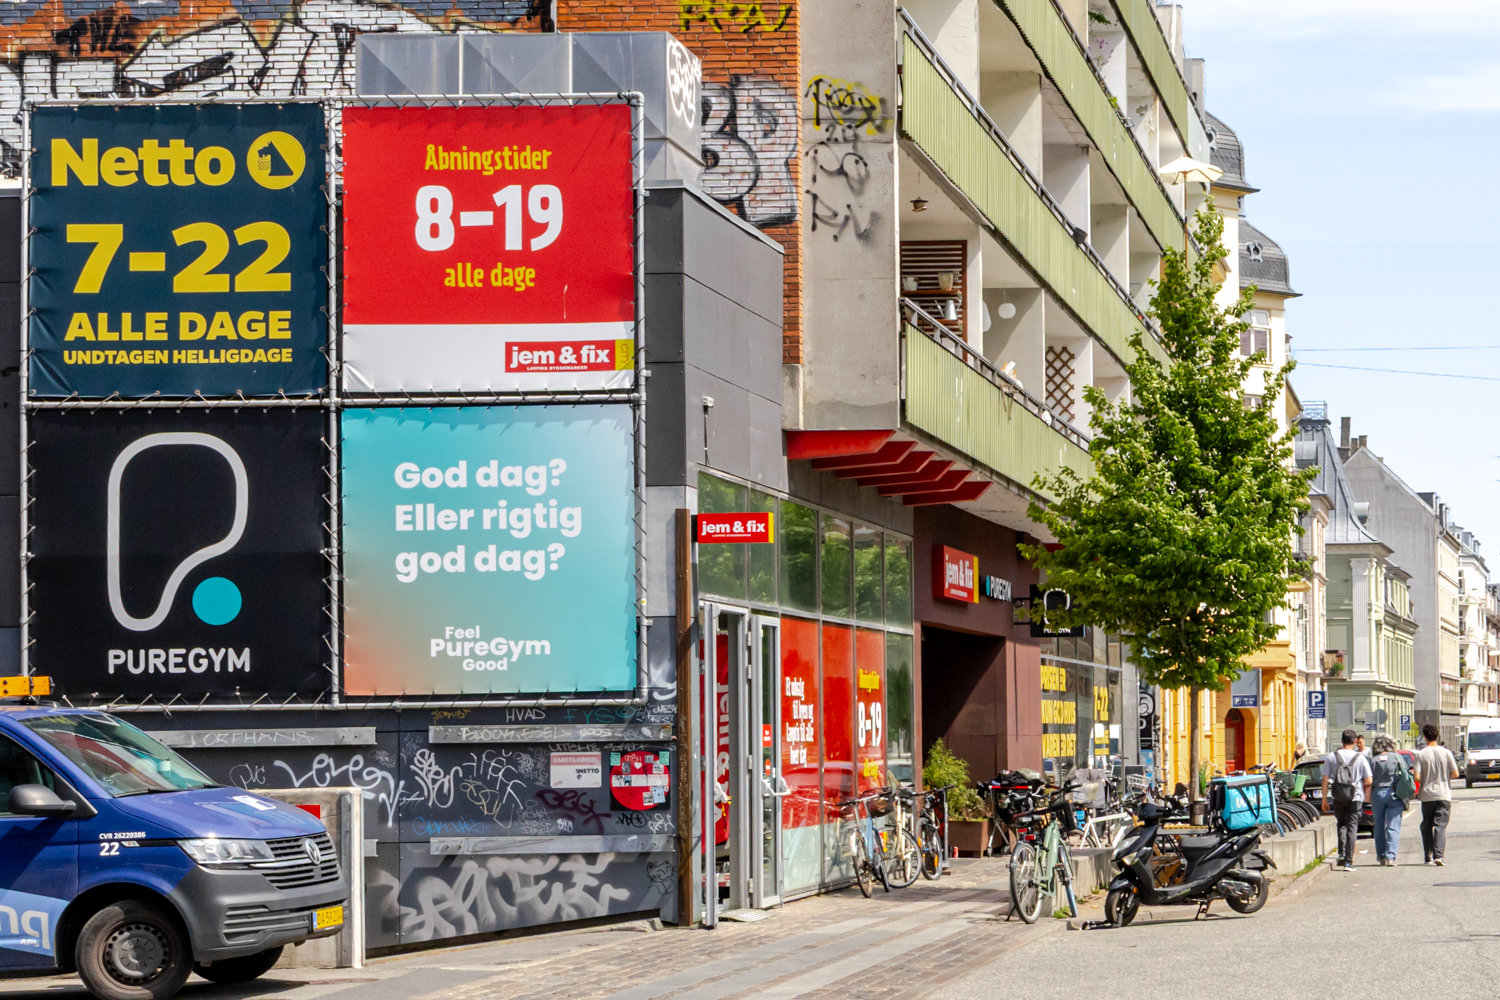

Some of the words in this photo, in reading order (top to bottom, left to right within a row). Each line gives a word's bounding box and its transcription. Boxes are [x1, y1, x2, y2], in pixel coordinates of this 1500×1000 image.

[51, 137, 235, 187] Netto
[425, 144, 552, 176] Åbningstider
[414, 184, 563, 252] 8-19
[65, 221, 292, 294] 7-22
[444, 263, 485, 290] alle
[490, 262, 535, 291] dage
[64, 311, 168, 342] ALLE
[178, 309, 292, 342] DAGE
[63, 349, 169, 366] UNDTAGEN
[172, 347, 293, 364] HELLIGDAGE
[510, 346, 555, 369] jem
[558, 345, 578, 364] &
[580, 344, 610, 363] fix
[394, 460, 468, 489] God
[475, 458, 567, 496] dag?
[394, 502, 474, 532] Eller
[481, 499, 582, 538] rigtig
[701, 520, 730, 536] jem
[732, 520, 745, 533] &
[746, 520, 766, 533] fix
[394, 544, 466, 583] god
[474, 541, 565, 580] dag?
[444, 624, 480, 640] Feel
[108, 648, 251, 675] PUREGYM
[430, 636, 551, 660] PureGym
[462, 656, 508, 671] Good
[1312, 693, 1322, 706] P
[505, 708, 546, 723] HVAD
[858, 701, 882, 747] 8-19
[1402, 716, 1409, 724] P
[100, 842, 120, 856] 22
